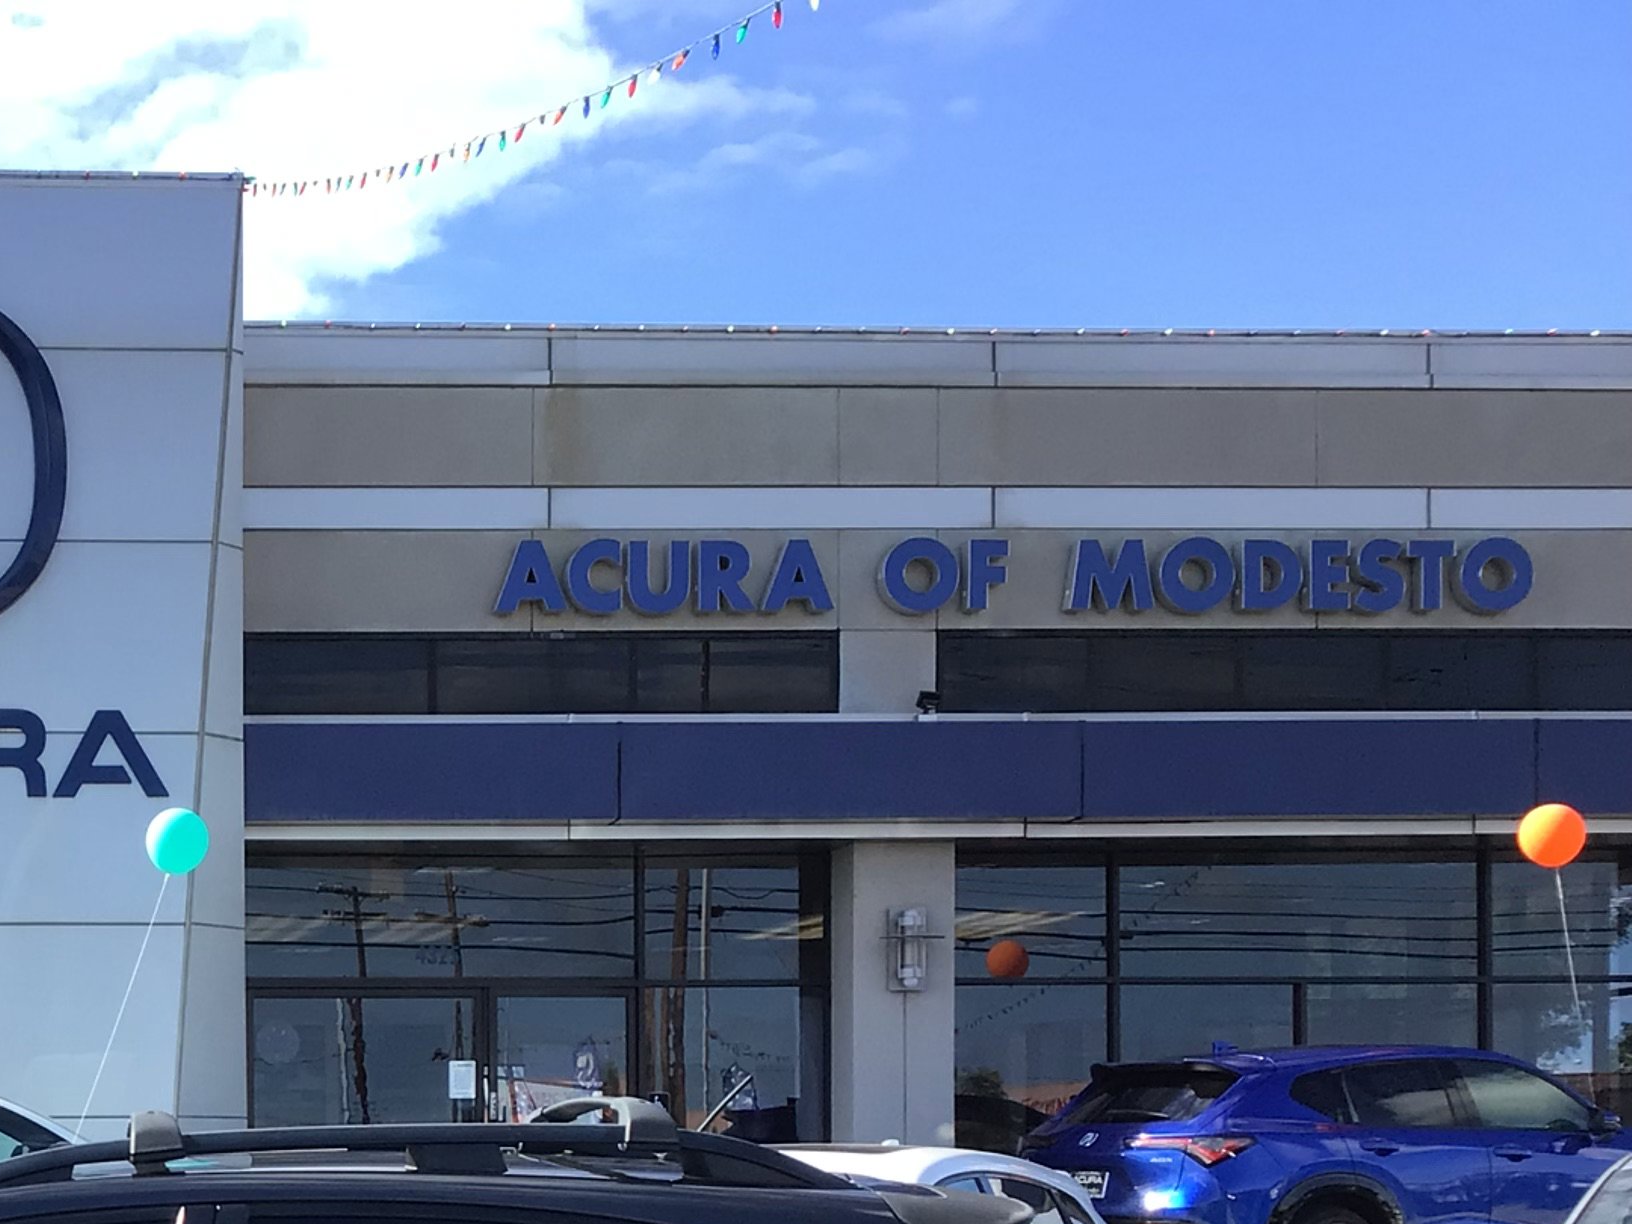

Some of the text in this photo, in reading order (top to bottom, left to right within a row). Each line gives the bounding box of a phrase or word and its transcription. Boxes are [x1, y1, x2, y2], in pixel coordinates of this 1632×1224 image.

[492, 535, 1535, 615] ACURA OF MODESTO
